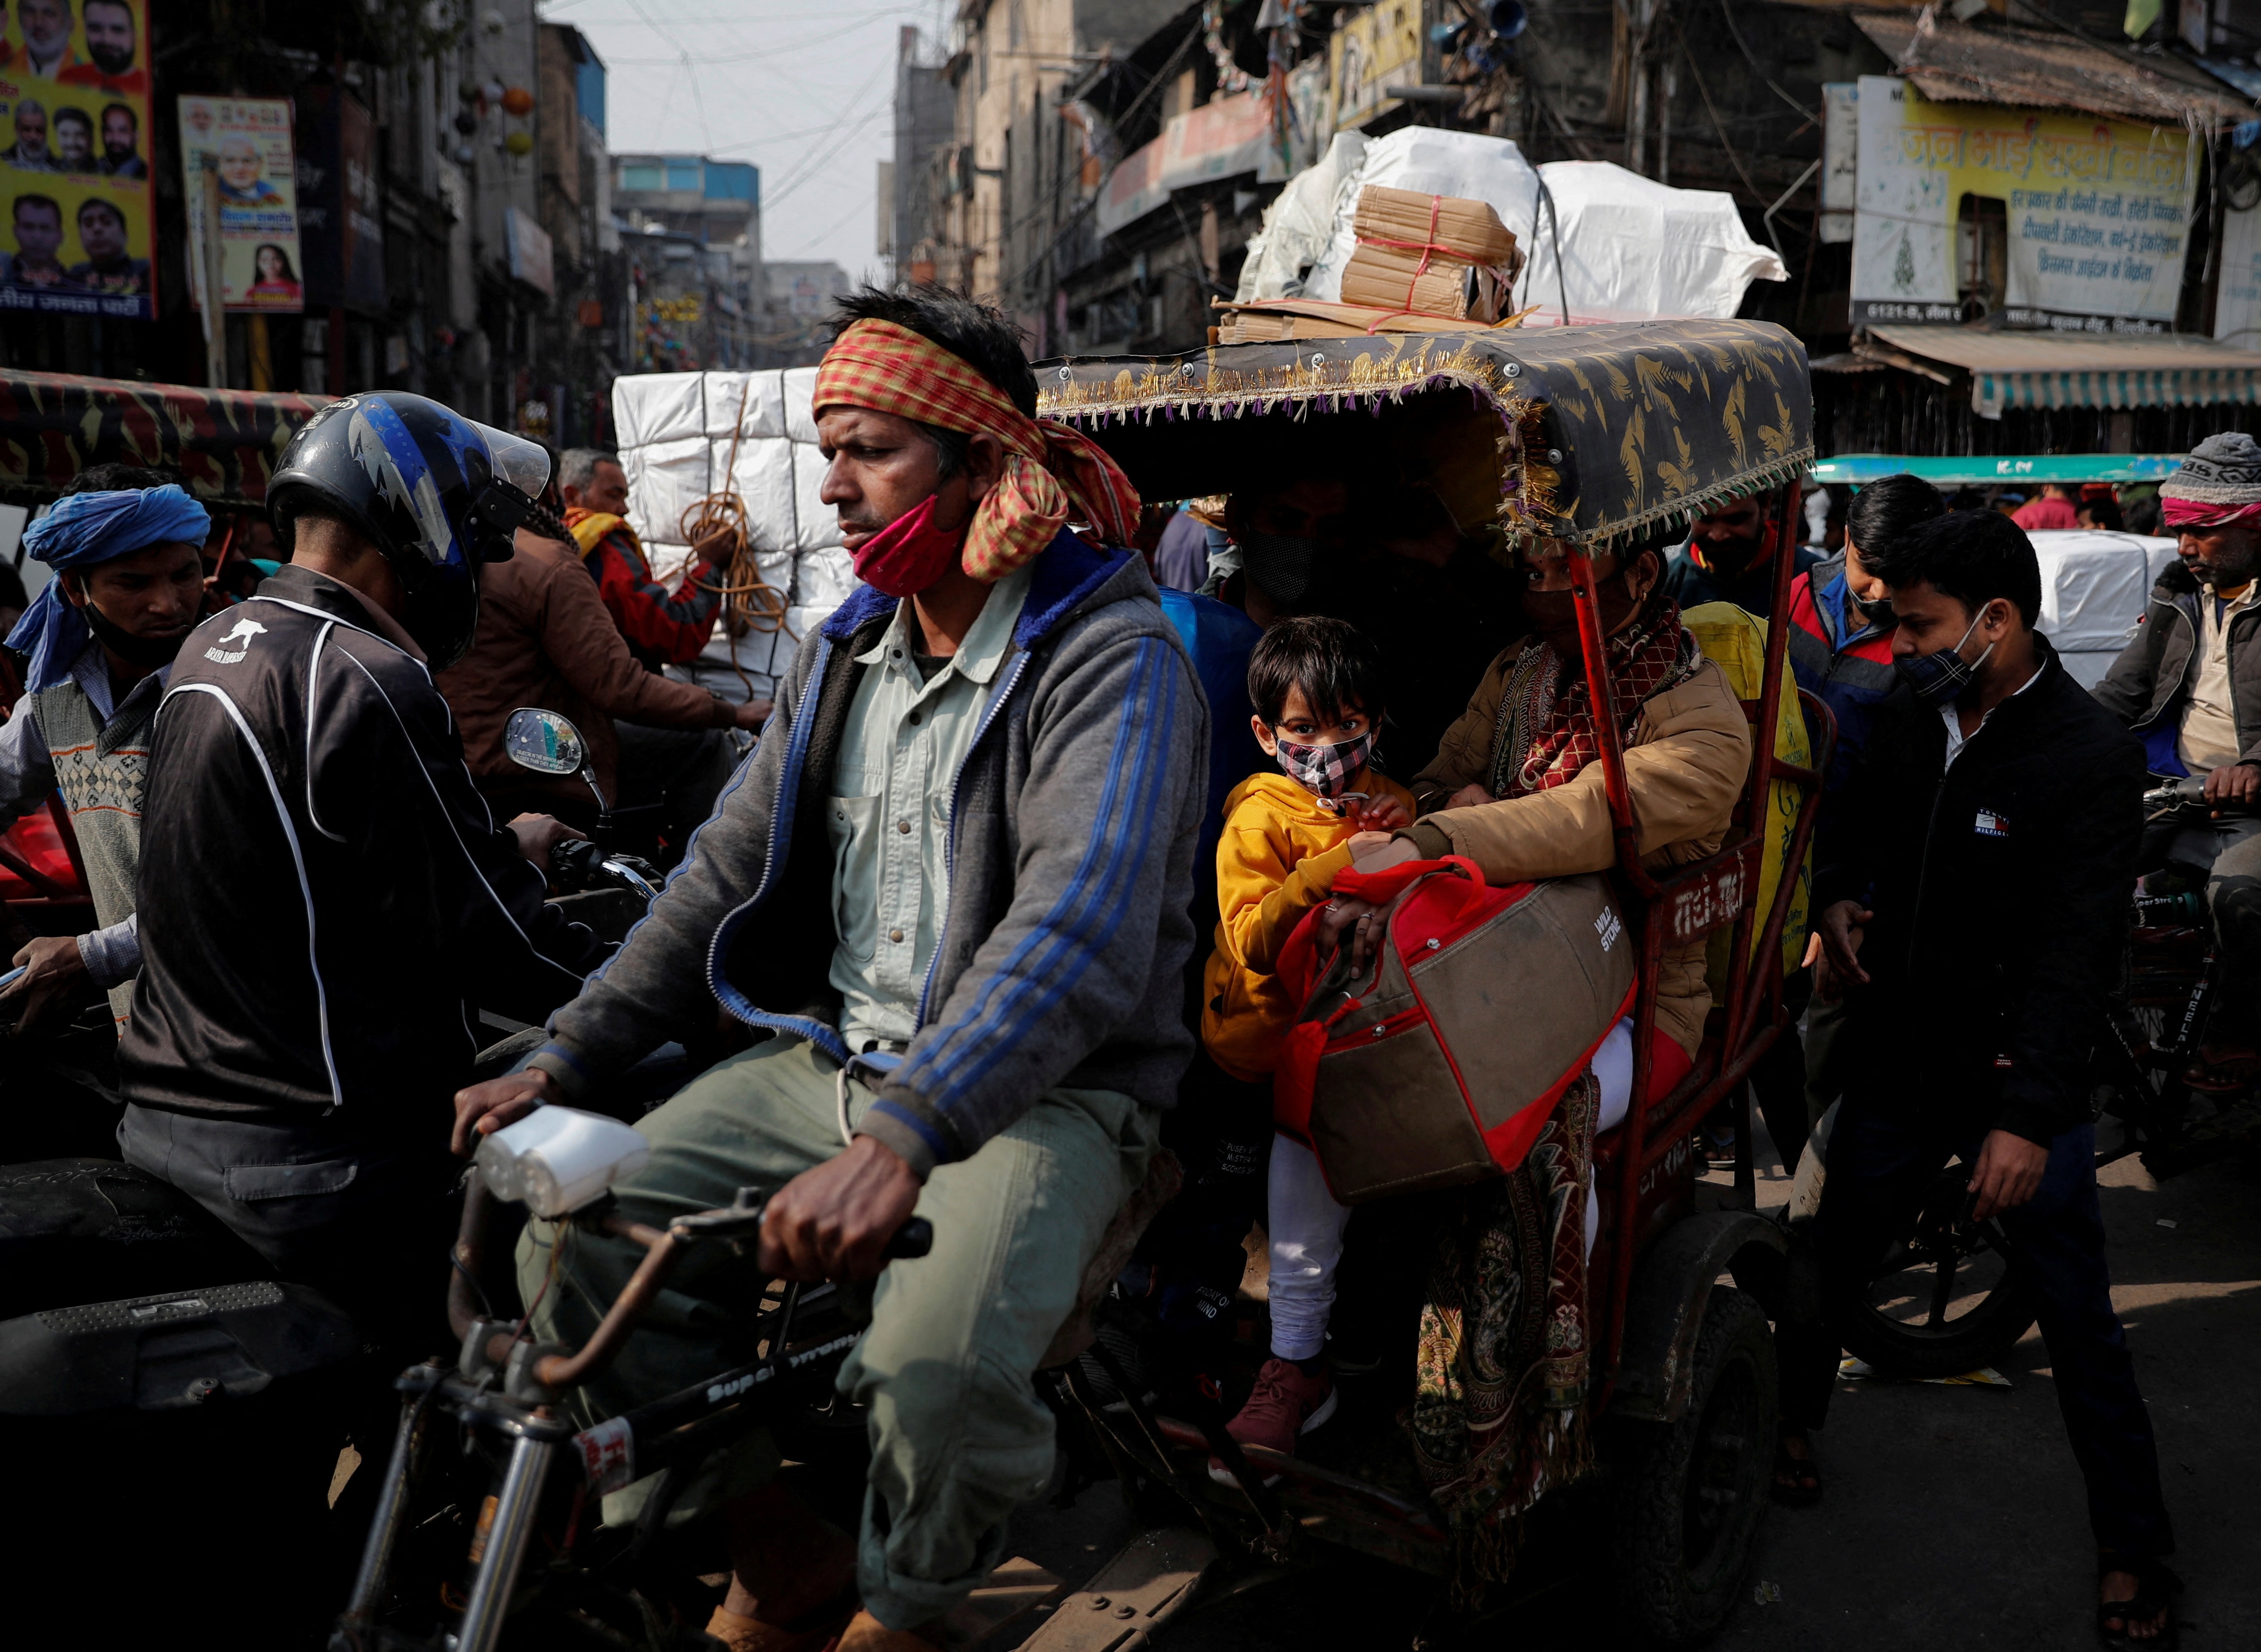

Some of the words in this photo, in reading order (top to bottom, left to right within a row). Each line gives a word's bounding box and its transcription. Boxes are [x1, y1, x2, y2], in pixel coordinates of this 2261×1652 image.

[1971, 117, 2037, 179] भाई
[2038, 123, 2117, 180] राखी
[2011, 189, 2024, 209] हर
[2027, 191, 2052, 210] प्रकार
[2057, 188, 2068, 211] की
[1593, 905, 1611, 935] WILD
[1600, 915, 1621, 952] STONE
[1196, 1299, 1218, 1318] MIND
